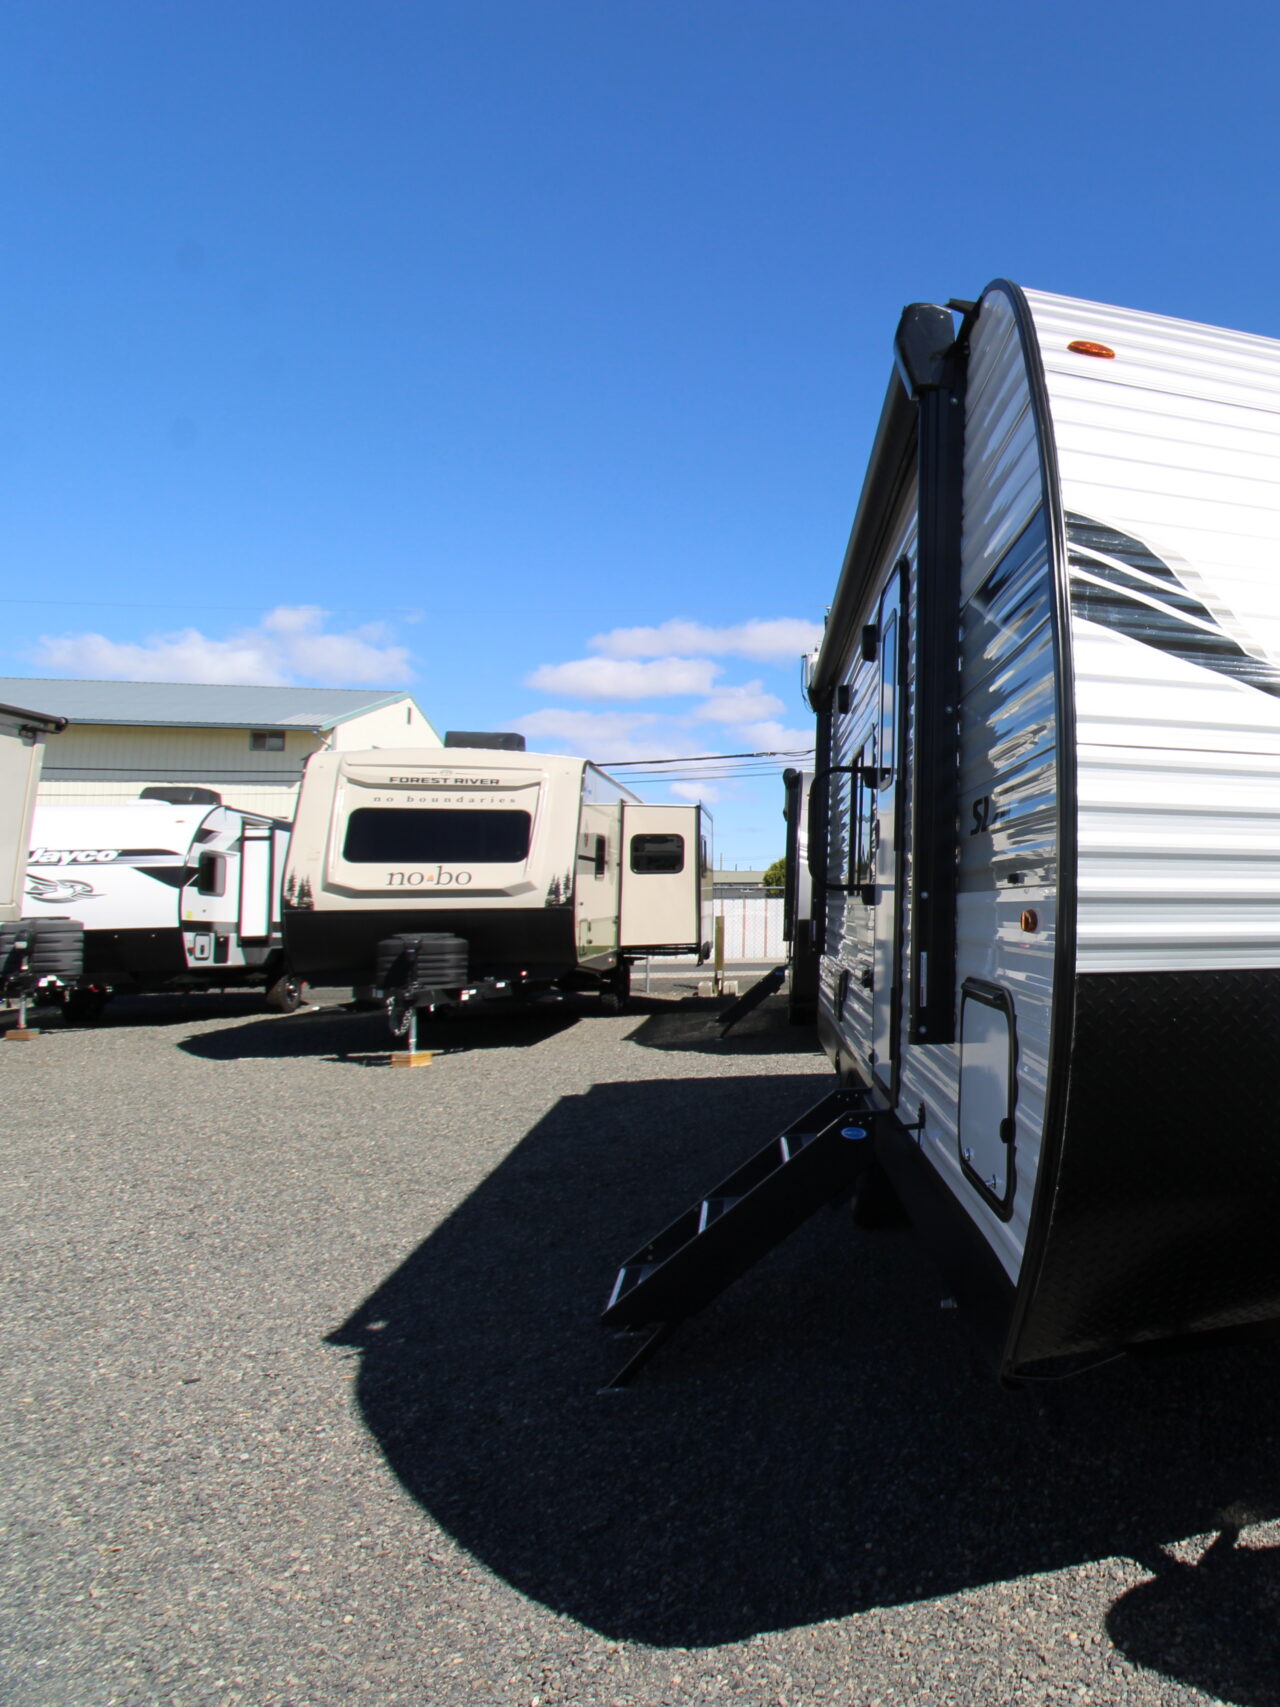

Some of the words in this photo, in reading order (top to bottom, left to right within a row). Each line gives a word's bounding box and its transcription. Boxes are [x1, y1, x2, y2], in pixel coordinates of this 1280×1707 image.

[388, 776, 450, 784] FOREST
[454, 777, 500, 785] RIVER
[406, 795, 516, 804] boundaries
[26, 847, 121, 866] Jayco
